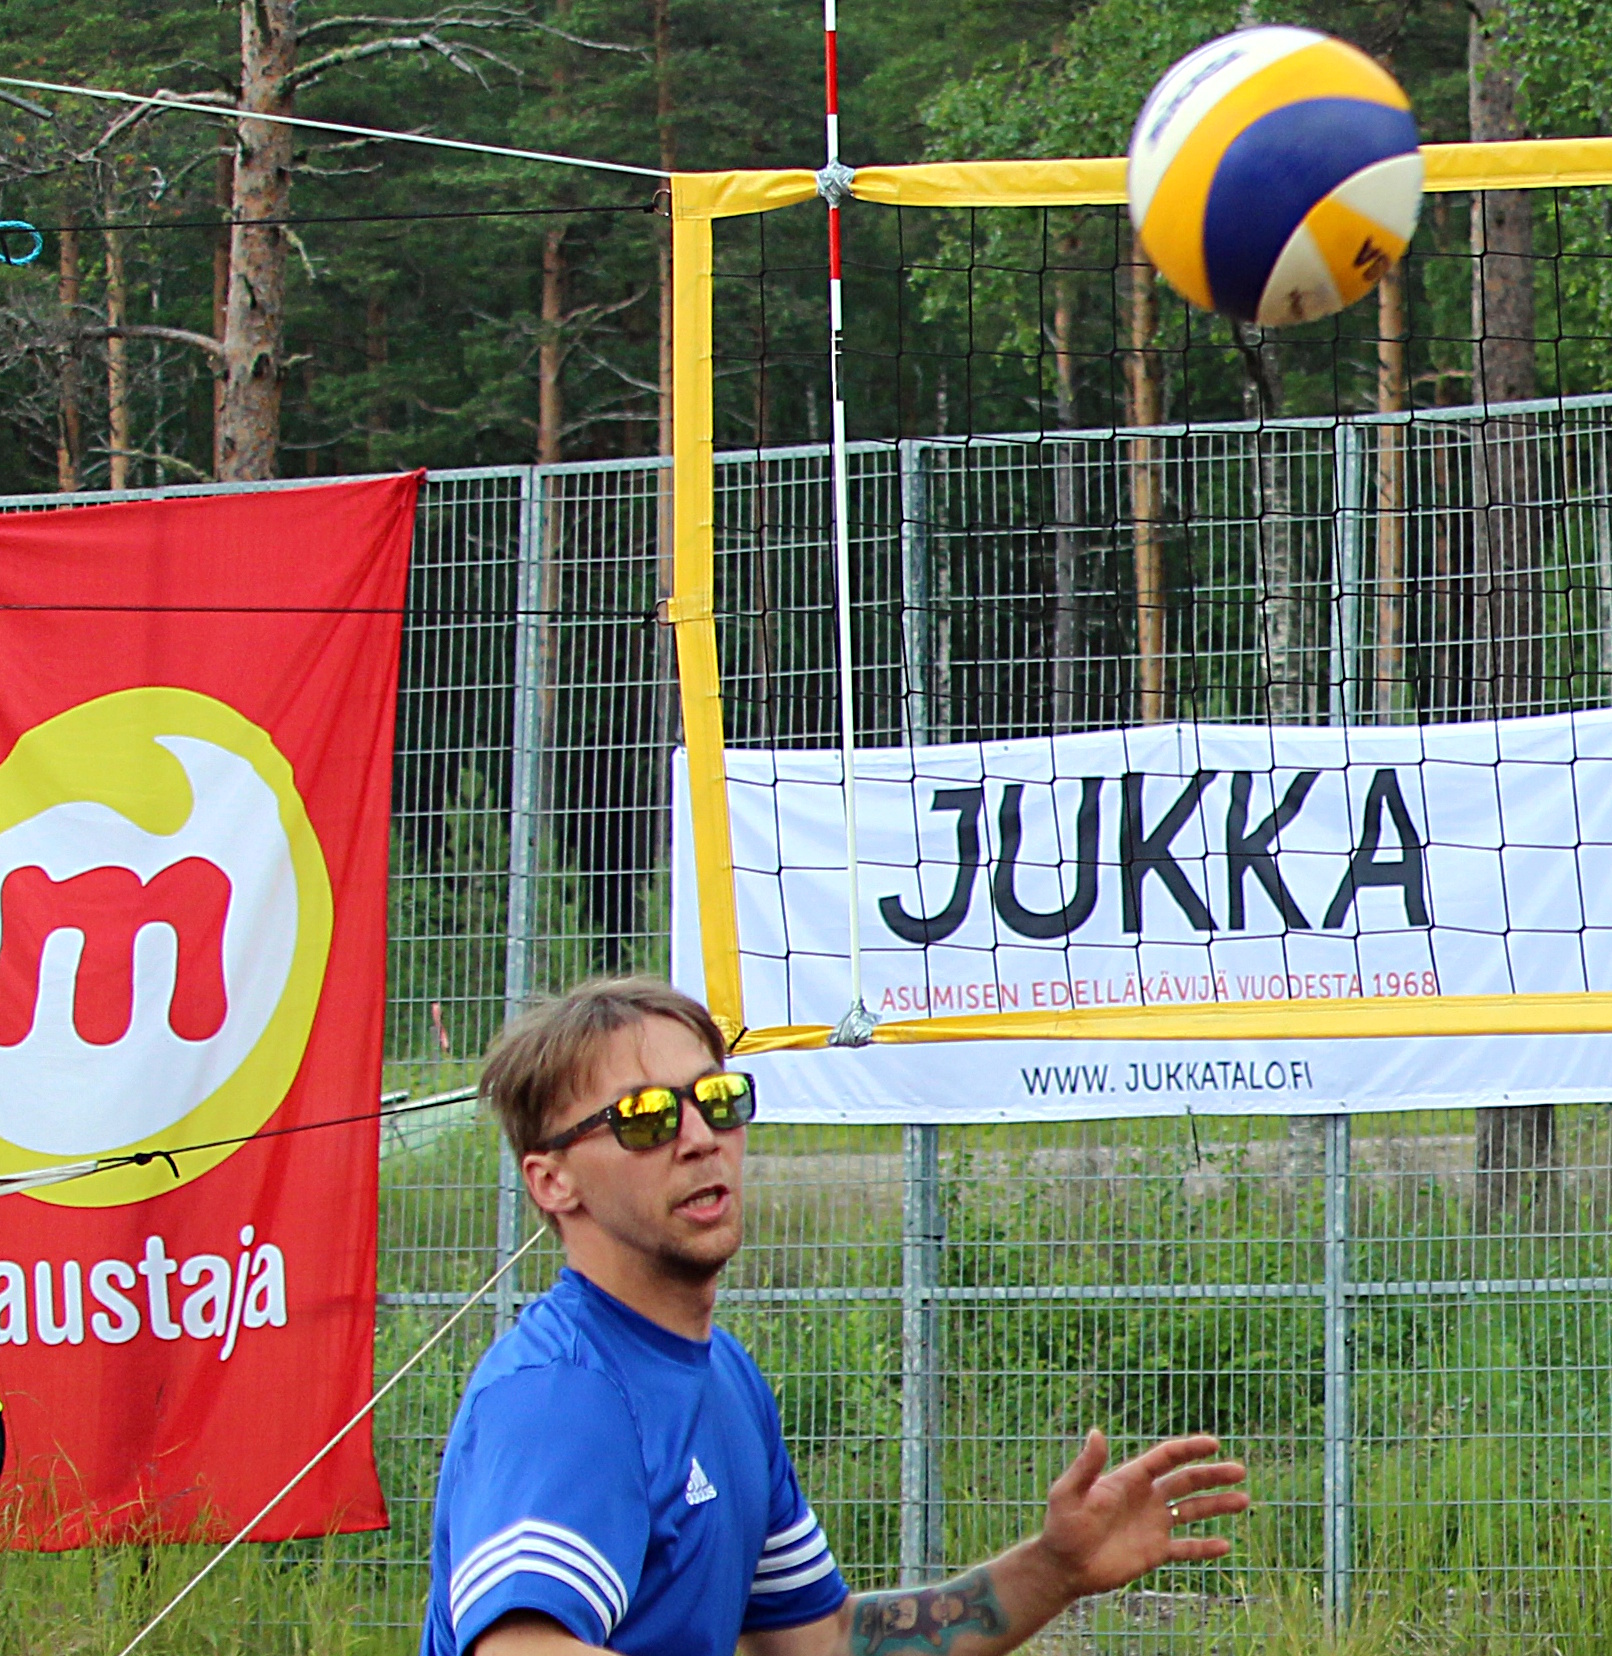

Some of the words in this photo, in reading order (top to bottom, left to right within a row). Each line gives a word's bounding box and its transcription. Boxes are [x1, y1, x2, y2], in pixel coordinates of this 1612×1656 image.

[878, 768, 1429, 943] JUKKA
[0, 856, 233, 1047] m
[880, 983, 1018, 1012] ASUMISEN
[1032, 970, 1229, 1007] EDELLÄKÄVIJÄ
[1236, 973, 1361, 1001] VUODESTA
[1373, 971, 1436, 998] 1968
[0, 1224, 287, 1361] austaja
